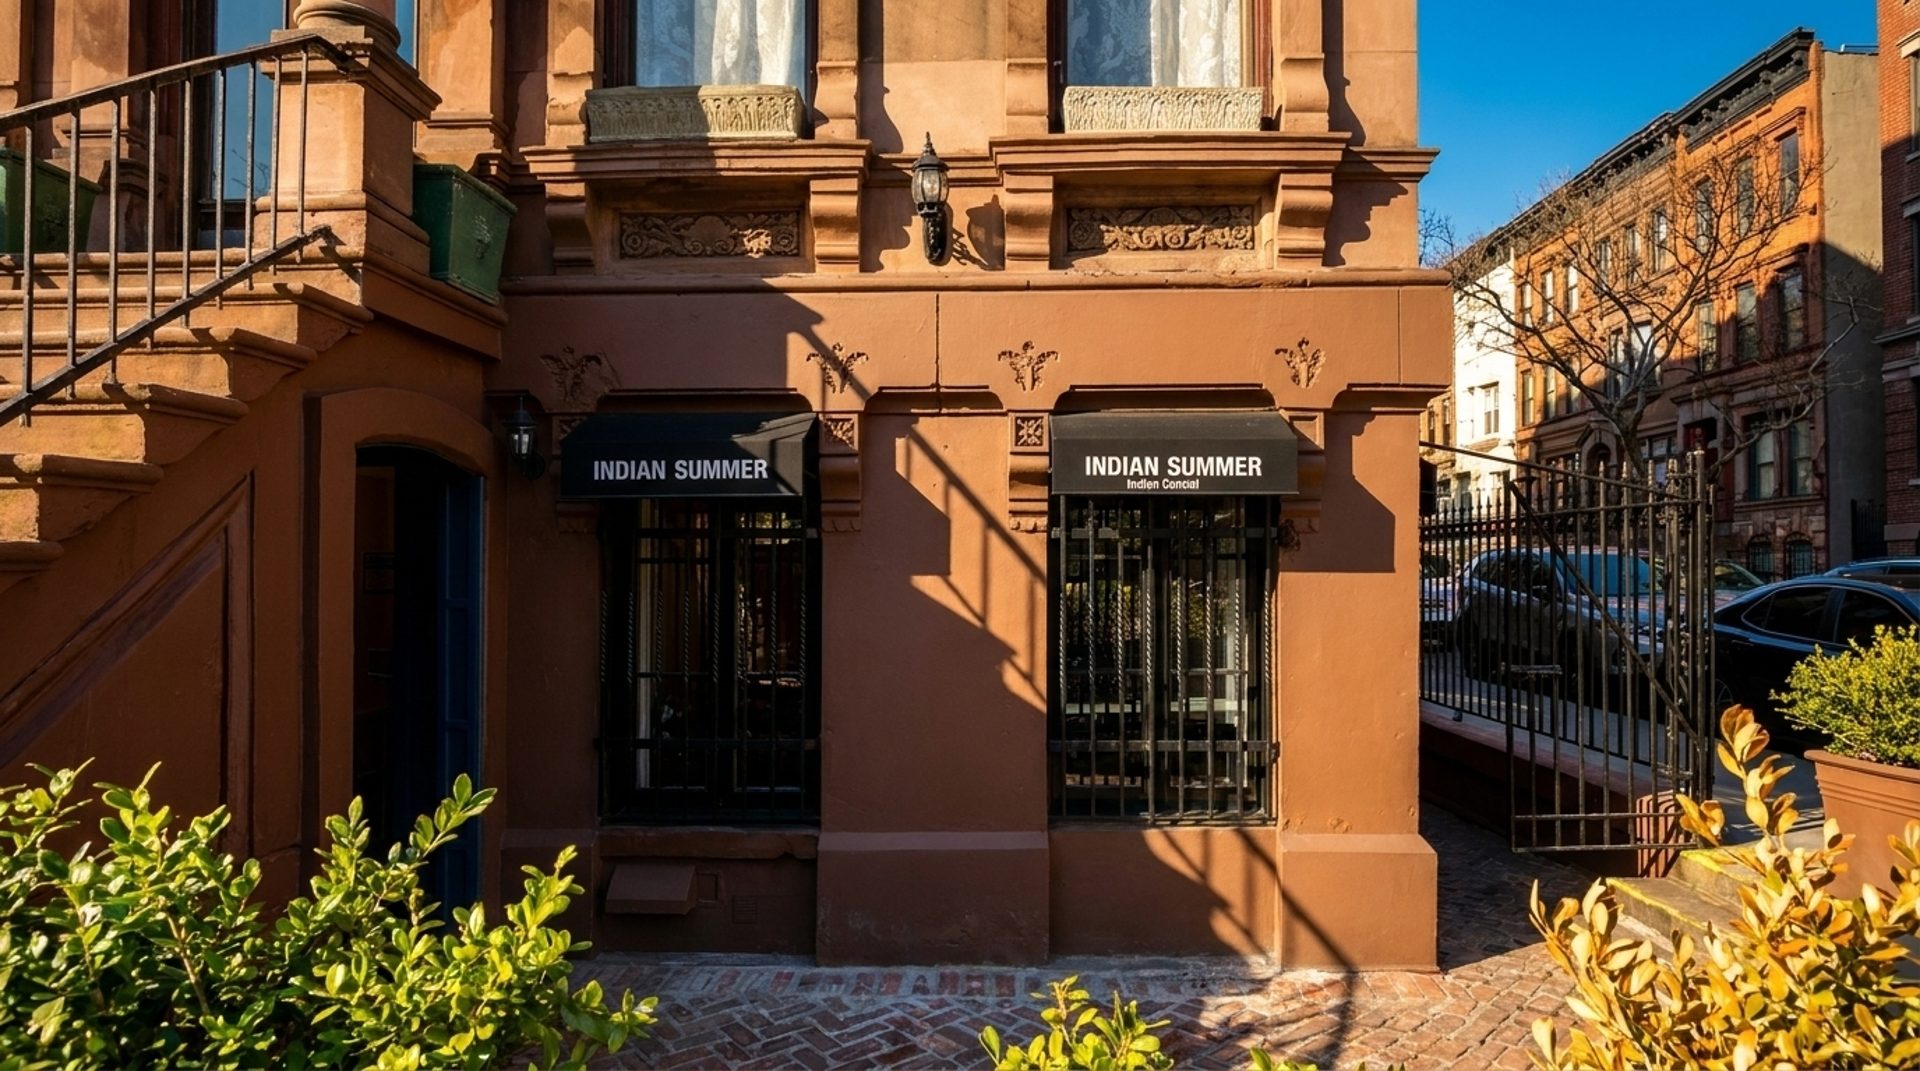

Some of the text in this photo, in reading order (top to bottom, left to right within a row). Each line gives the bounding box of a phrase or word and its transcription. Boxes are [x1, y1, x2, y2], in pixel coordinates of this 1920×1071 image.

[593, 459, 768, 480] INDIAN SUMMER
[1085, 455, 1262, 477] INDIAN SUMMER
